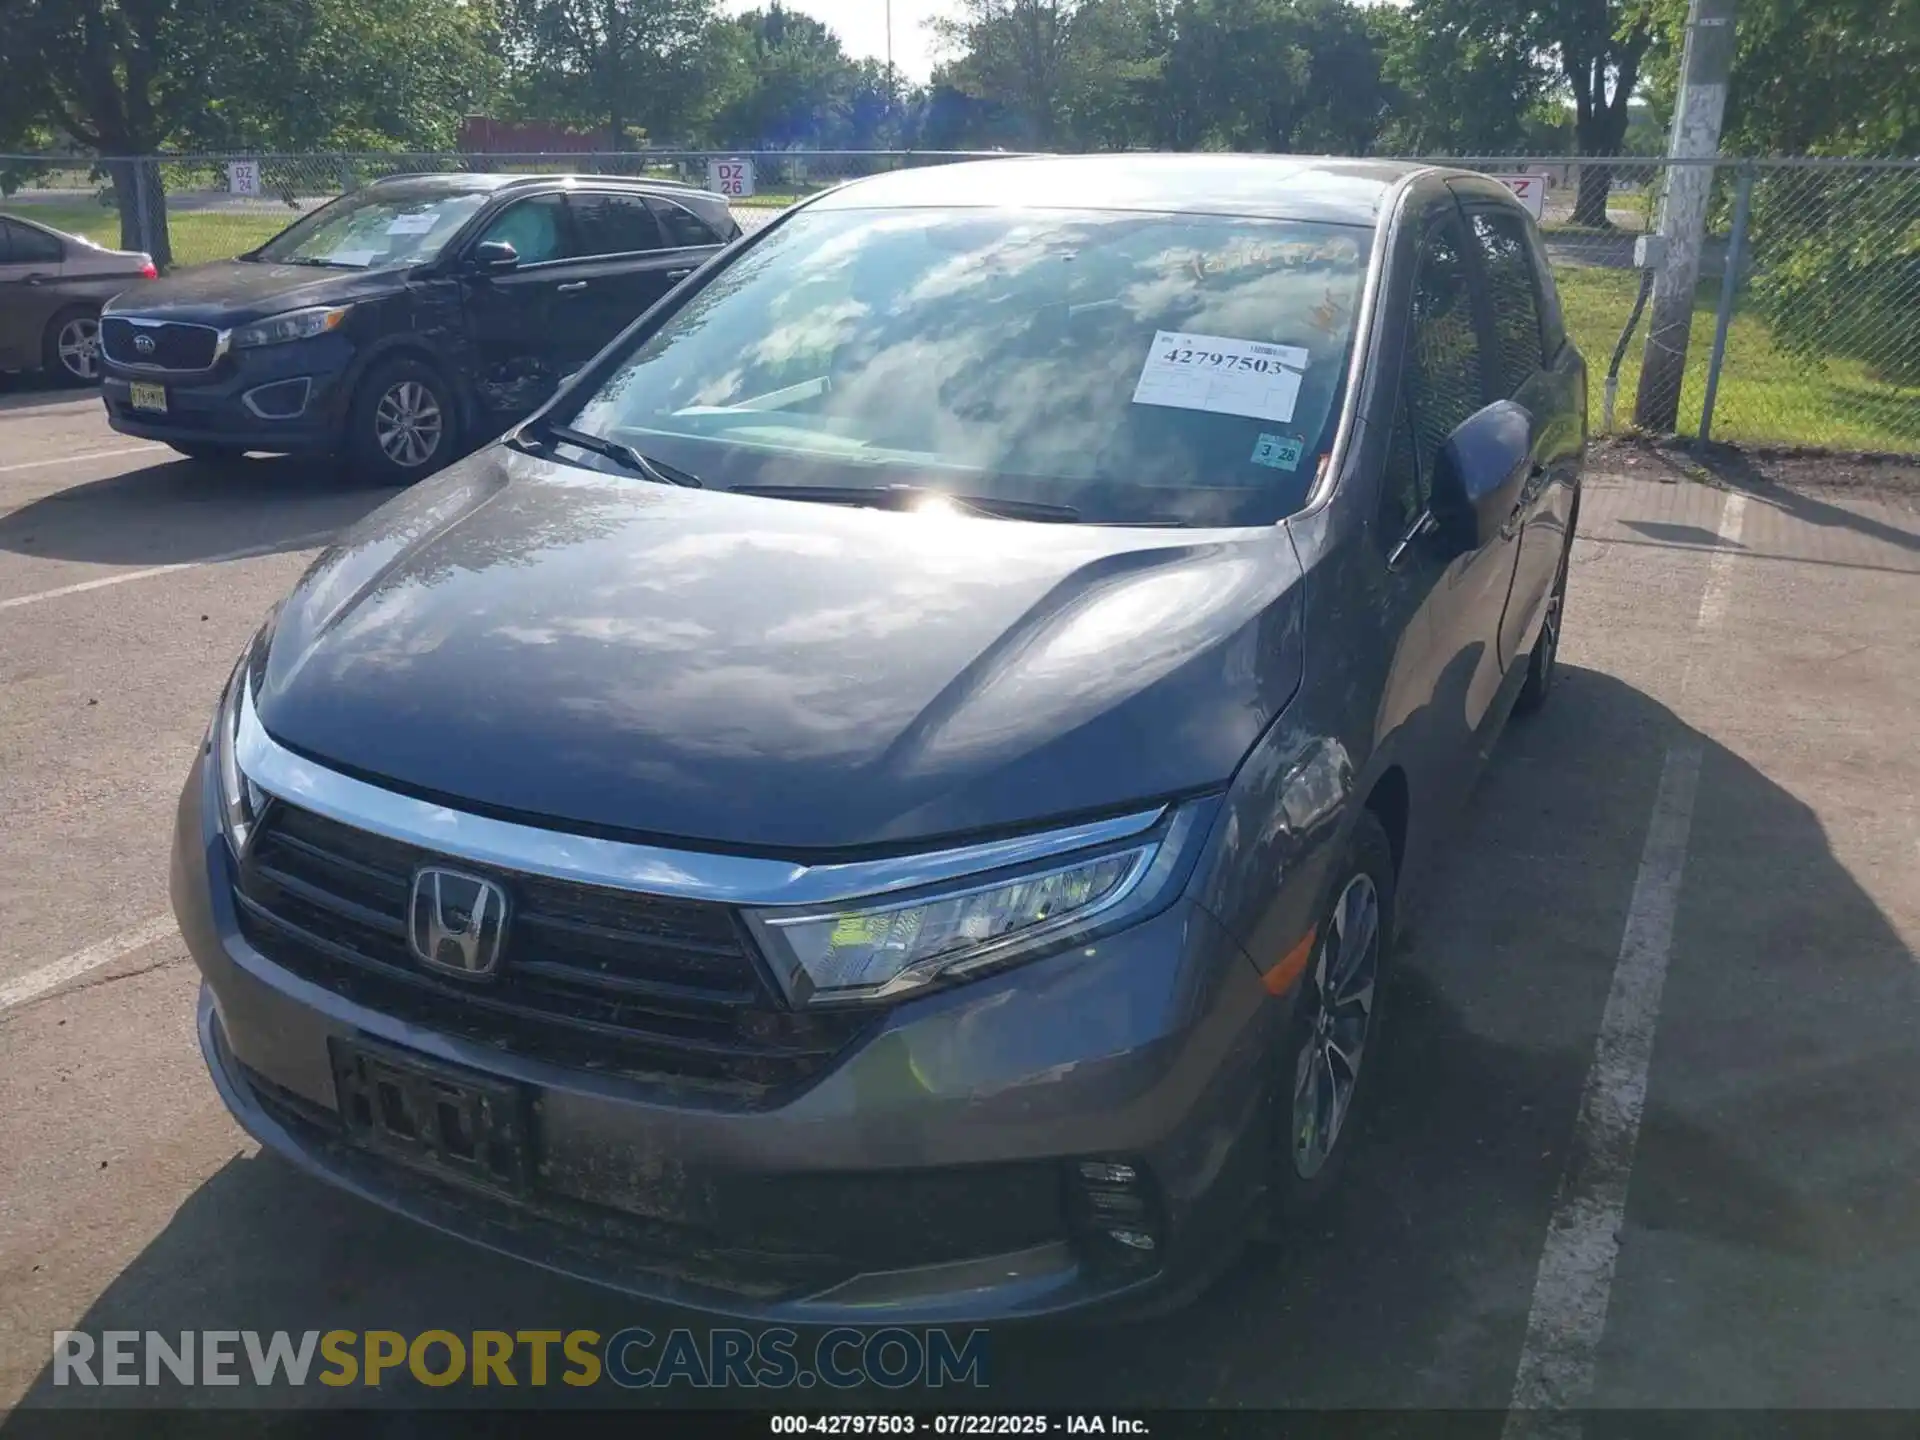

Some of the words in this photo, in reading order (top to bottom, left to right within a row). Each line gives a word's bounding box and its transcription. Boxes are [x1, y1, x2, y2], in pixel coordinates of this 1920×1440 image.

[235, 166, 252, 178] DZ
[718, 164, 743, 179] DZ
[721, 180, 742, 194] 26
[1163, 348, 1282, 375] 42797503
[1261, 444, 1272, 456] 3
[1277, 447, 1296, 461] 28
